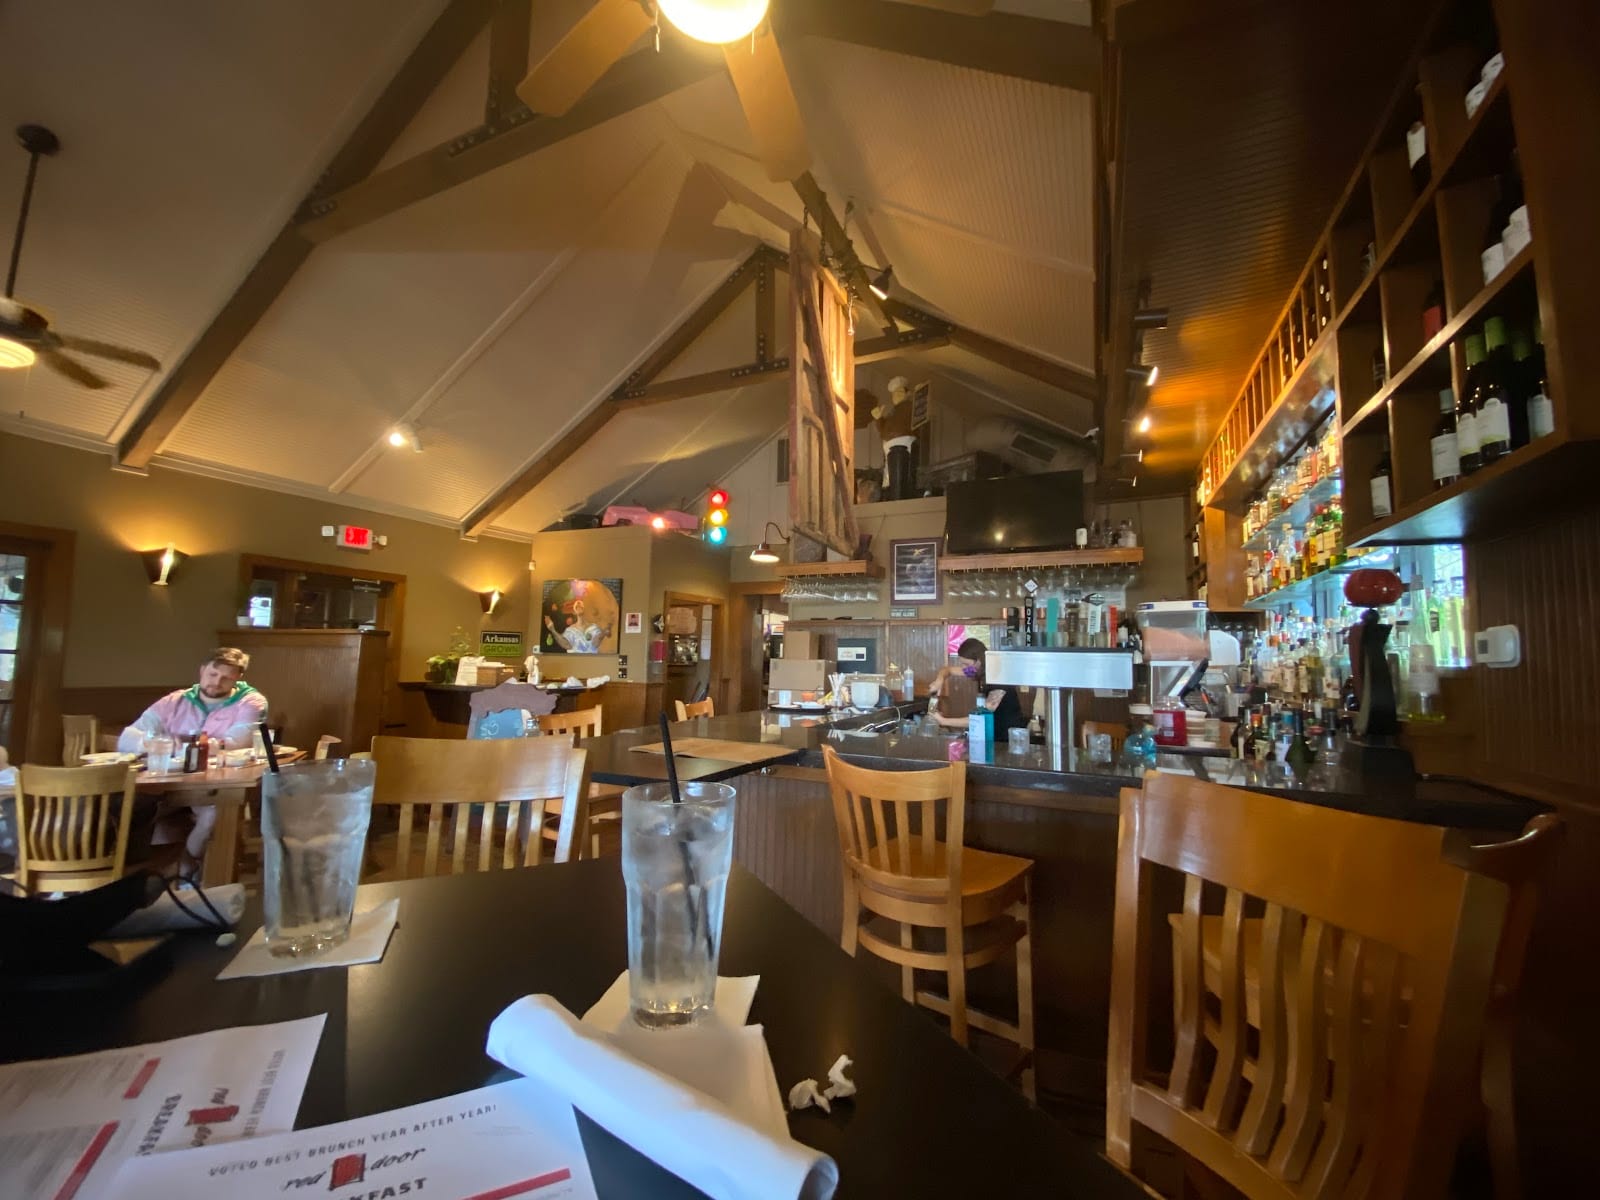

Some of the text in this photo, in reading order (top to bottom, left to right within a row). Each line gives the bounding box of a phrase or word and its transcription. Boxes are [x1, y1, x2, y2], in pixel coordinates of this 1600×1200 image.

[484, 634, 519, 643] Arkansas
[484, 645, 519, 653] GROWN
[208, 1104, 497, 1177] VOTED BEST BRUNCH YEAR AFTER YEAR!
[283, 1148, 426, 1191] red door
